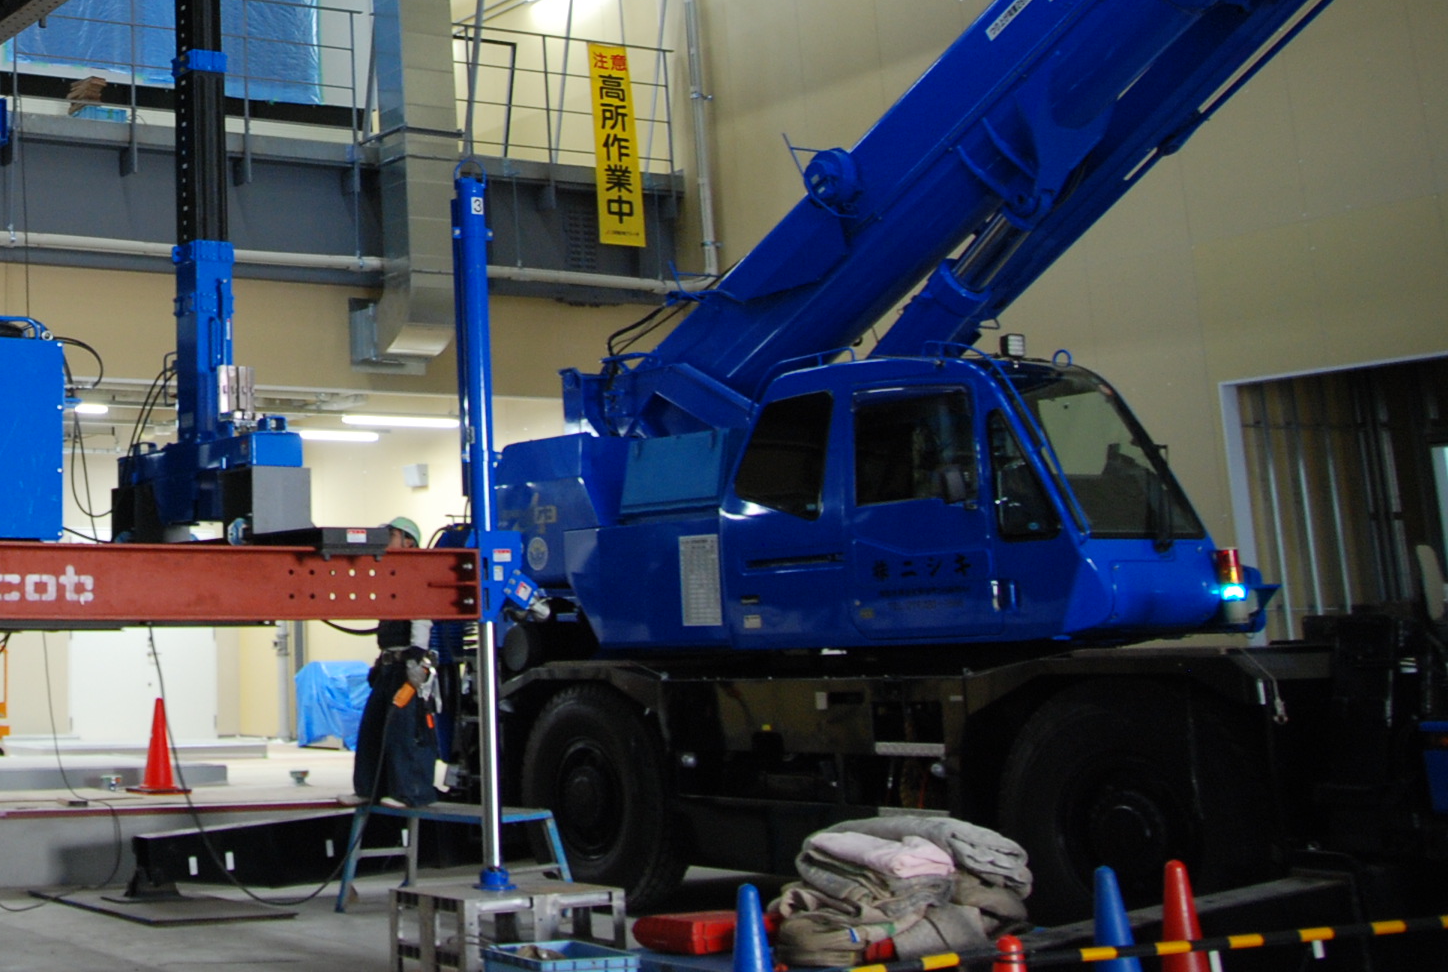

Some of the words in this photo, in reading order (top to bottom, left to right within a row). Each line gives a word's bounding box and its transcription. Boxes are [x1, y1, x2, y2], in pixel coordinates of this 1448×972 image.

[593, 52, 627, 72] 注意
[598, 73, 635, 225] 高所作業中
[473, 199, 482, 213] 3
